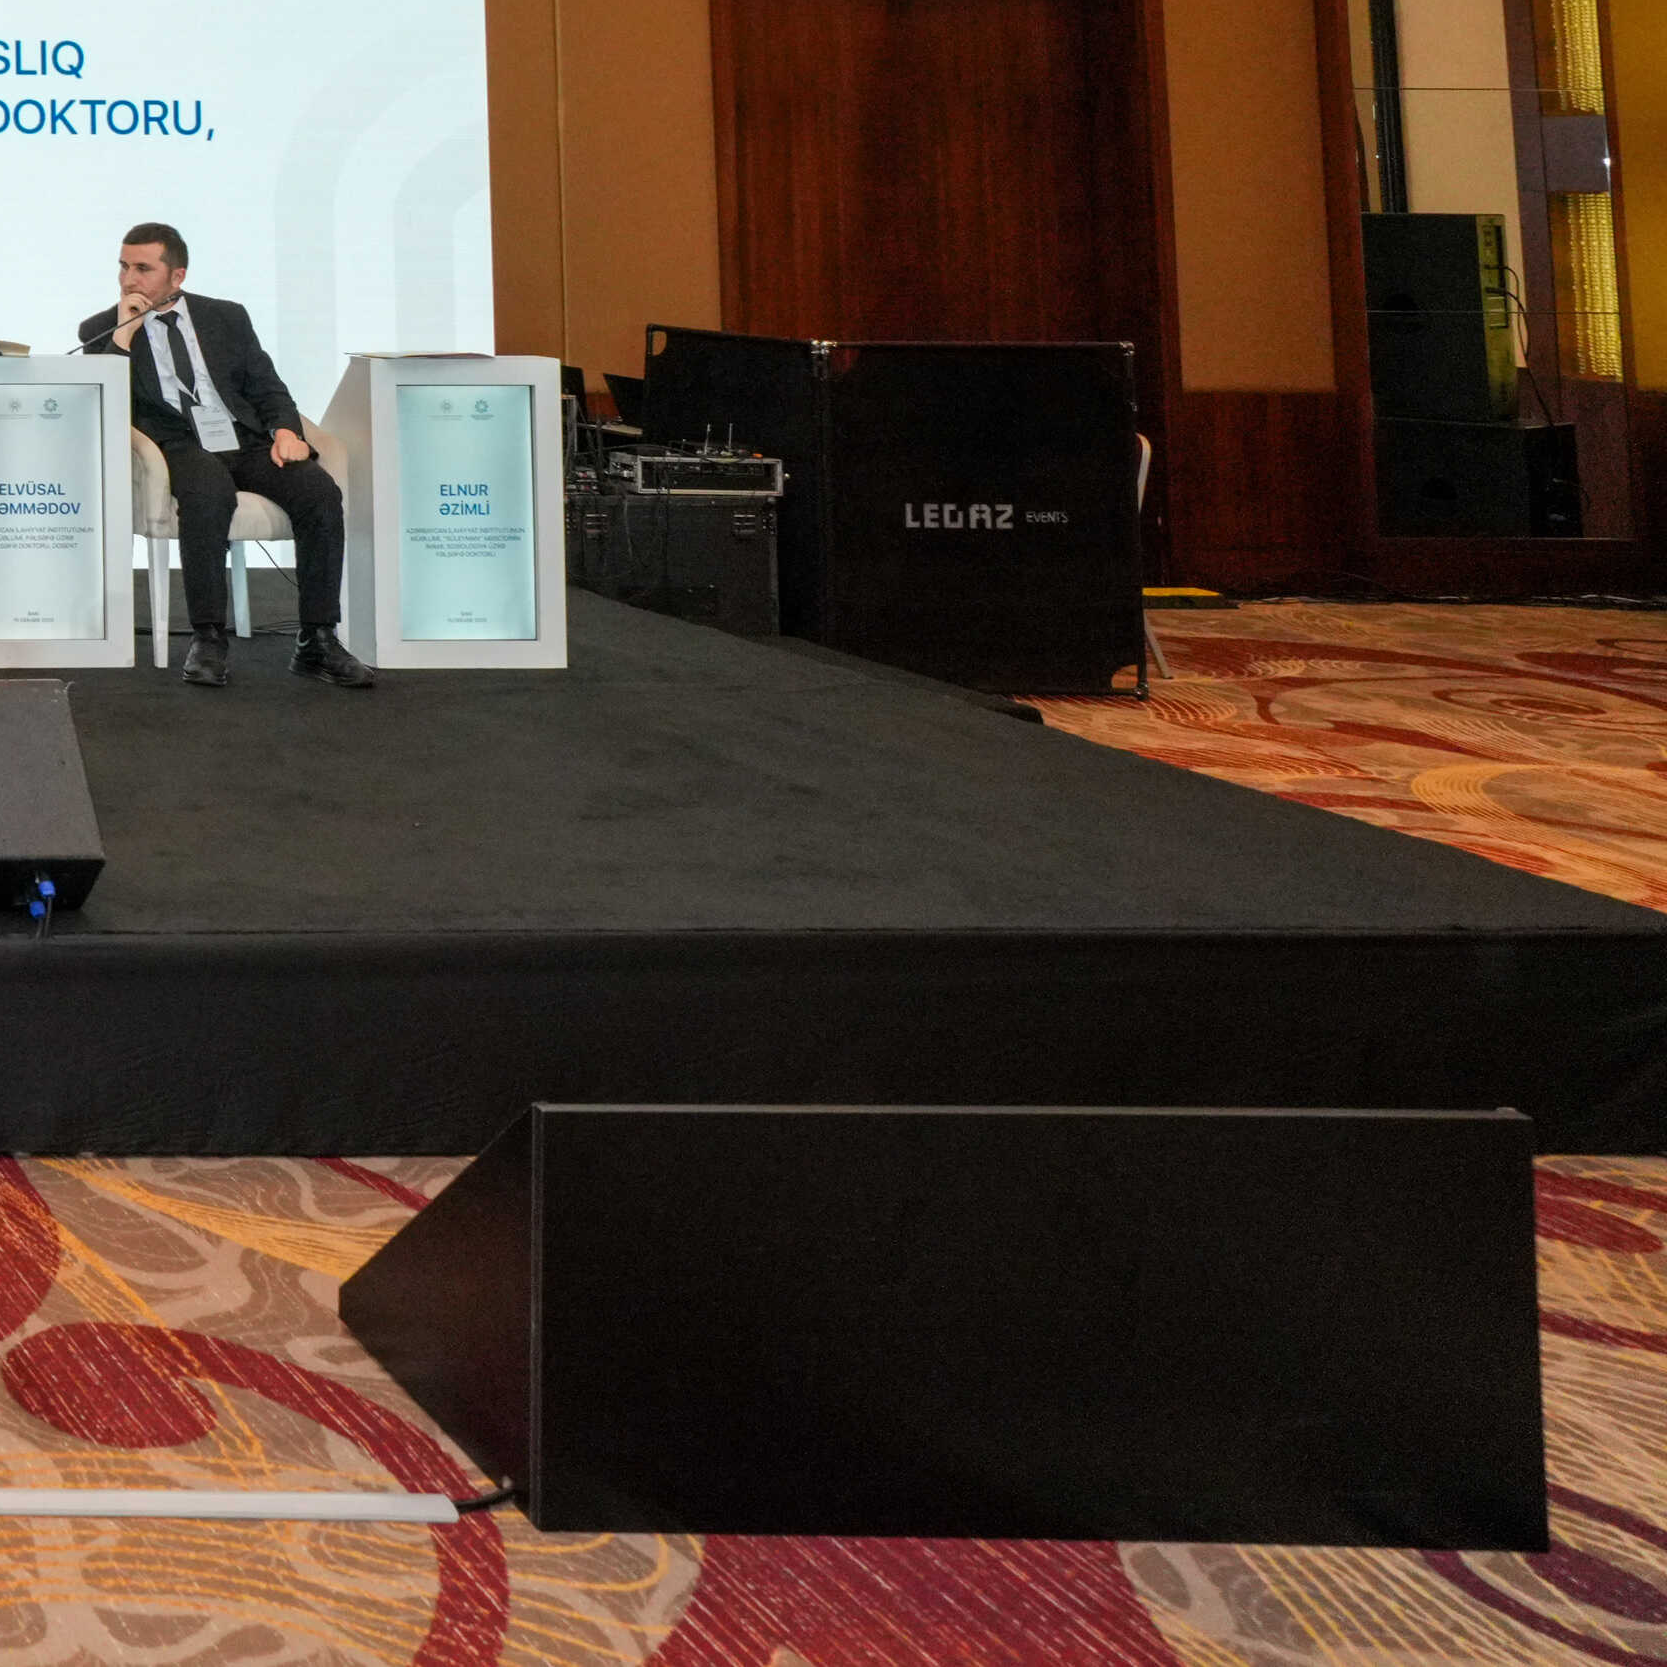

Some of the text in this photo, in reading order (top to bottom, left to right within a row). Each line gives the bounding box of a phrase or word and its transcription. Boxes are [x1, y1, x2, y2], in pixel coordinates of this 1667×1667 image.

[440, 484, 488, 496] ELNUR
[440, 499, 490, 516] ƏZİMLİ
[1026, 511, 1068, 523] EVENTS
